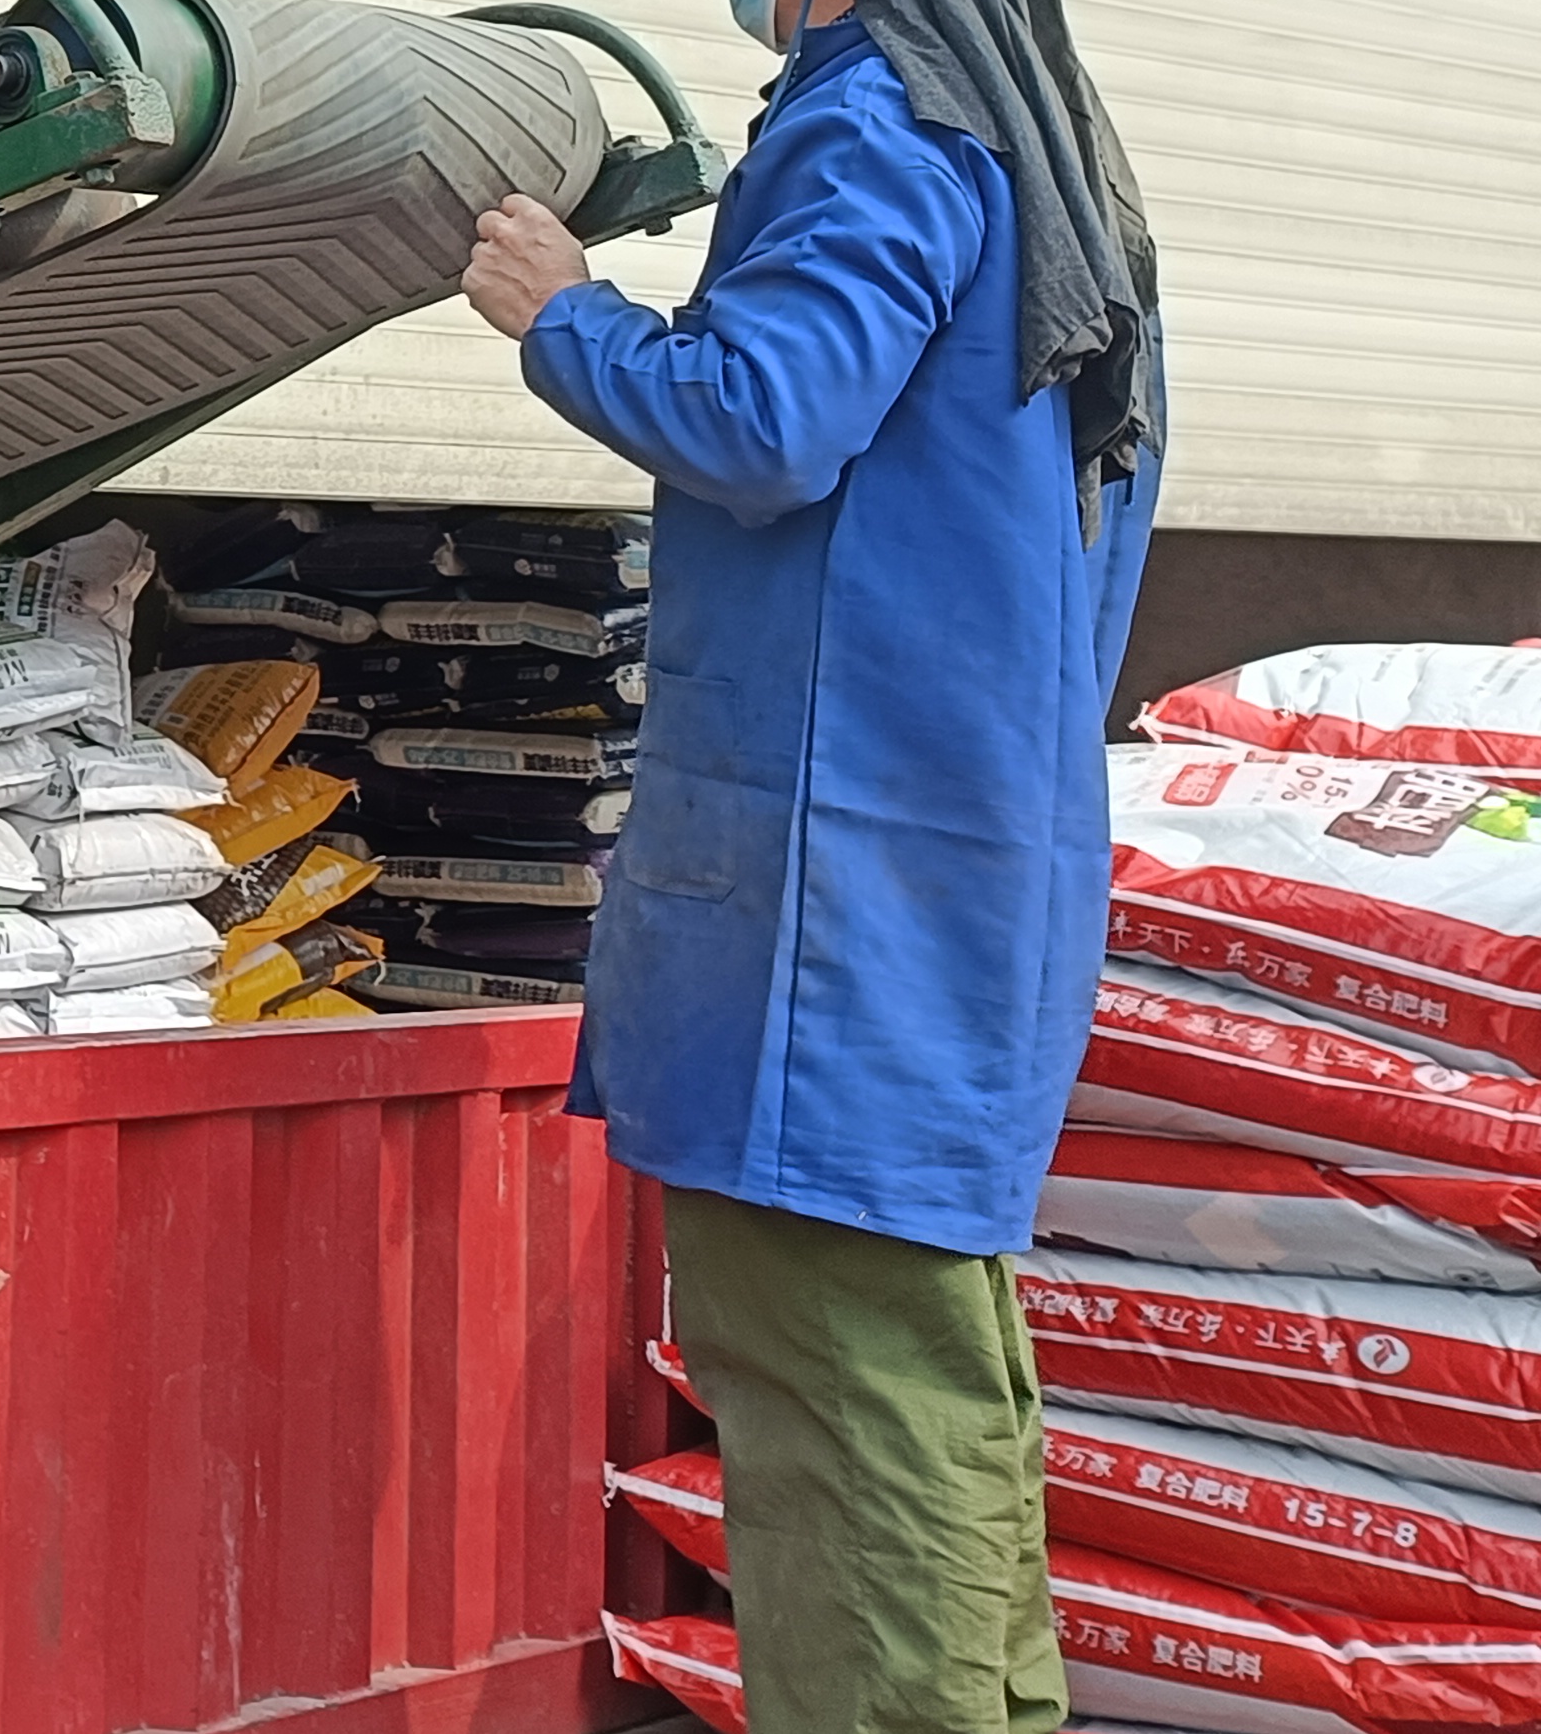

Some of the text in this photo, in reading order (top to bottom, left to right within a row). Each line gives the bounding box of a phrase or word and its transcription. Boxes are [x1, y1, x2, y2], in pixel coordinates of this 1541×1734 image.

[1333, 974, 1450, 1030] 复合肥料
[1132, 1462, 1251, 1514] 复合肥料
[1282, 1496, 1420, 1549] 15-7-8
[1151, 1632, 1264, 1684] 复合肥料
